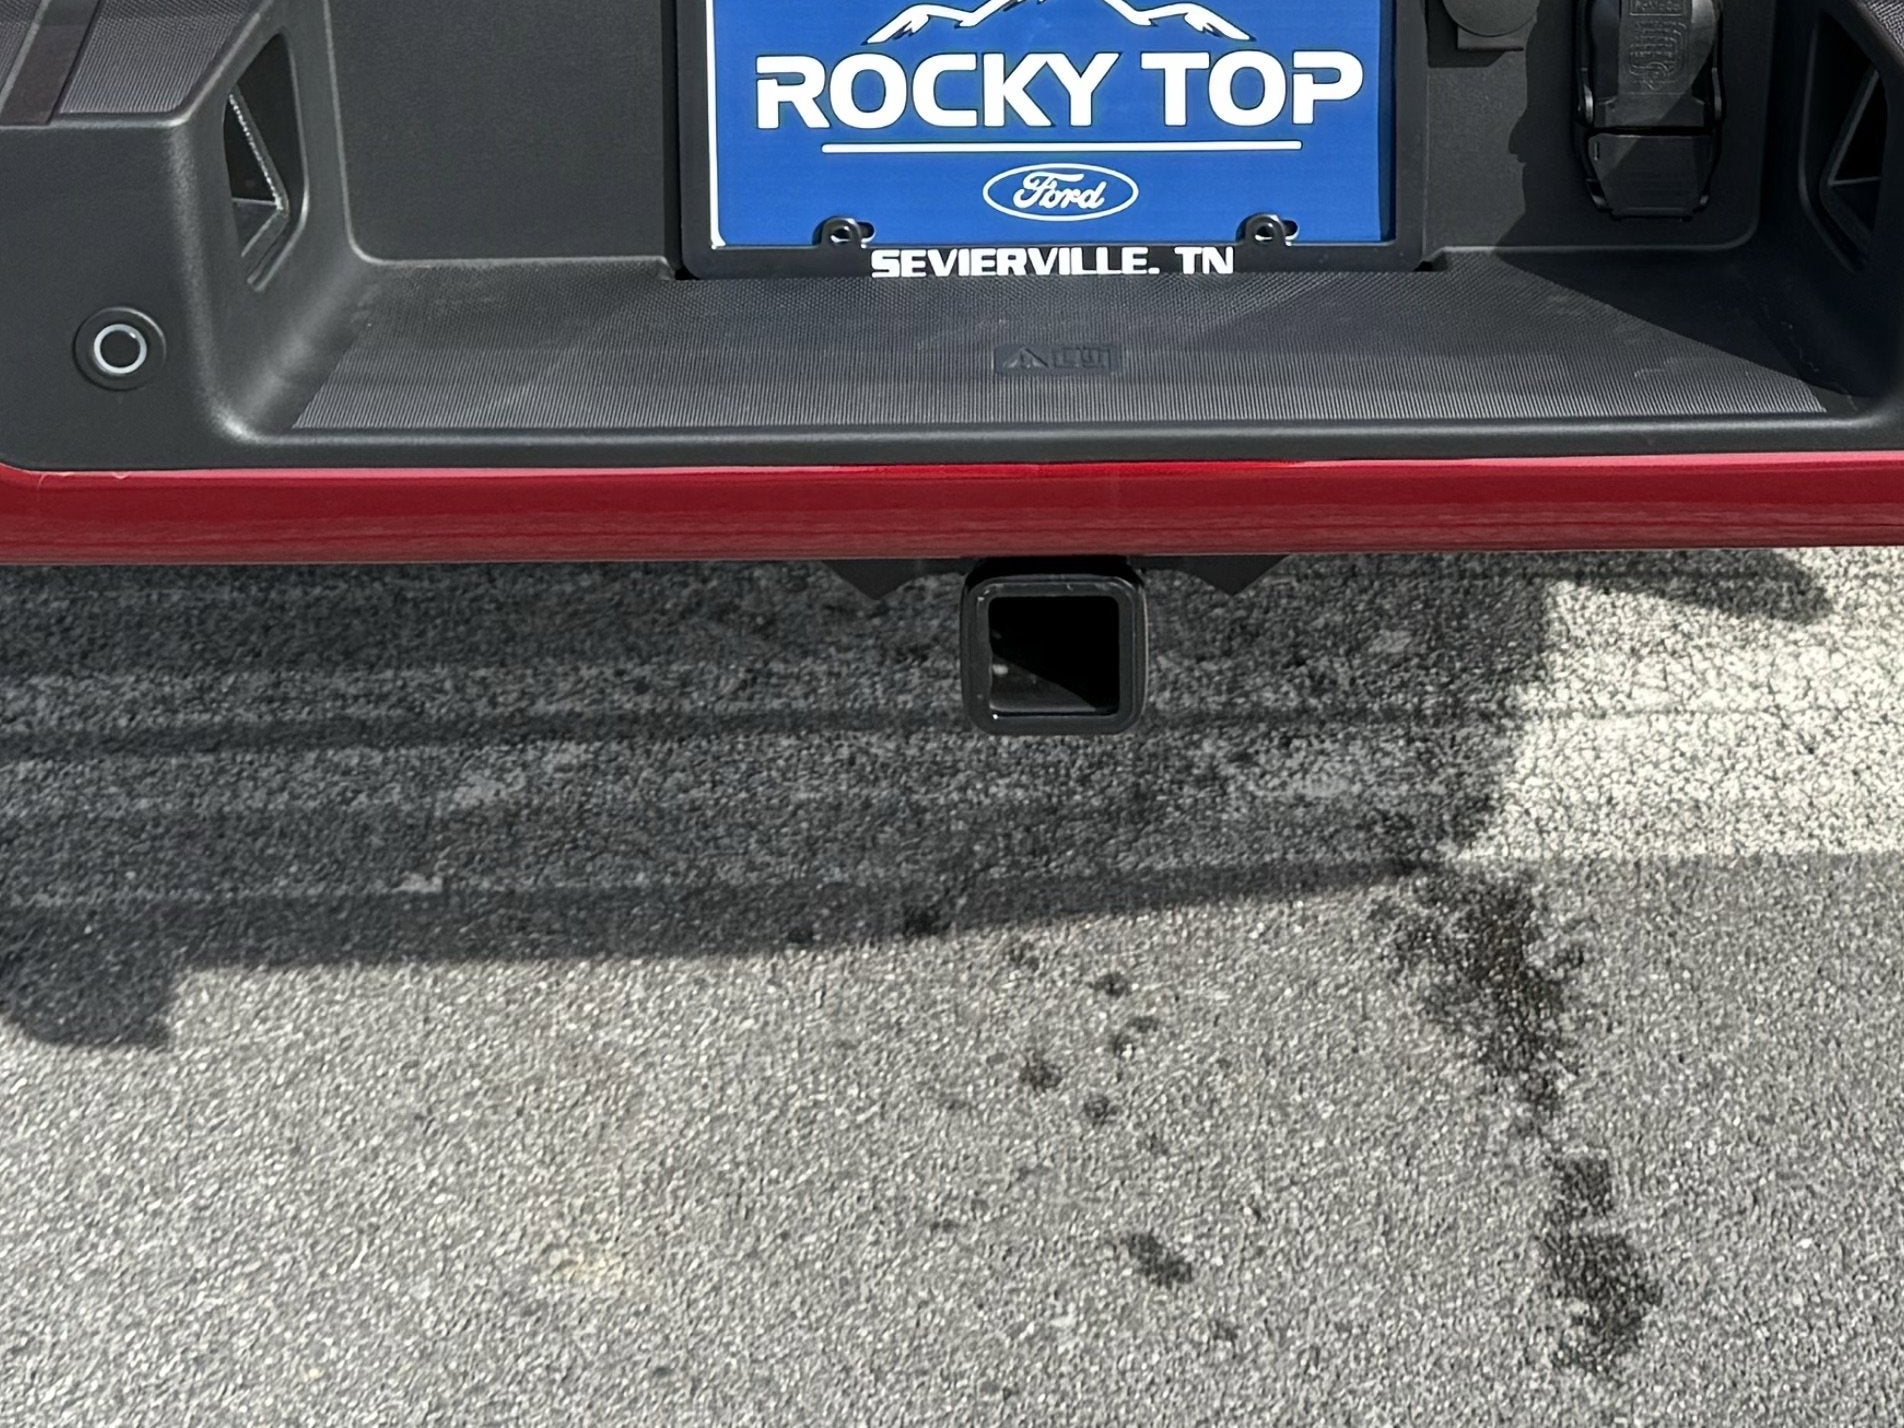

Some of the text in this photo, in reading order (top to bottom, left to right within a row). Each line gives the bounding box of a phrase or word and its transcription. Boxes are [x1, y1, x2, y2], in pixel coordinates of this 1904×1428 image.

[755, 50, 1364, 129] ROCKY TOP
[1013, 169, 1106, 213] Ford
[1174, 247, 1234, 275] TN
